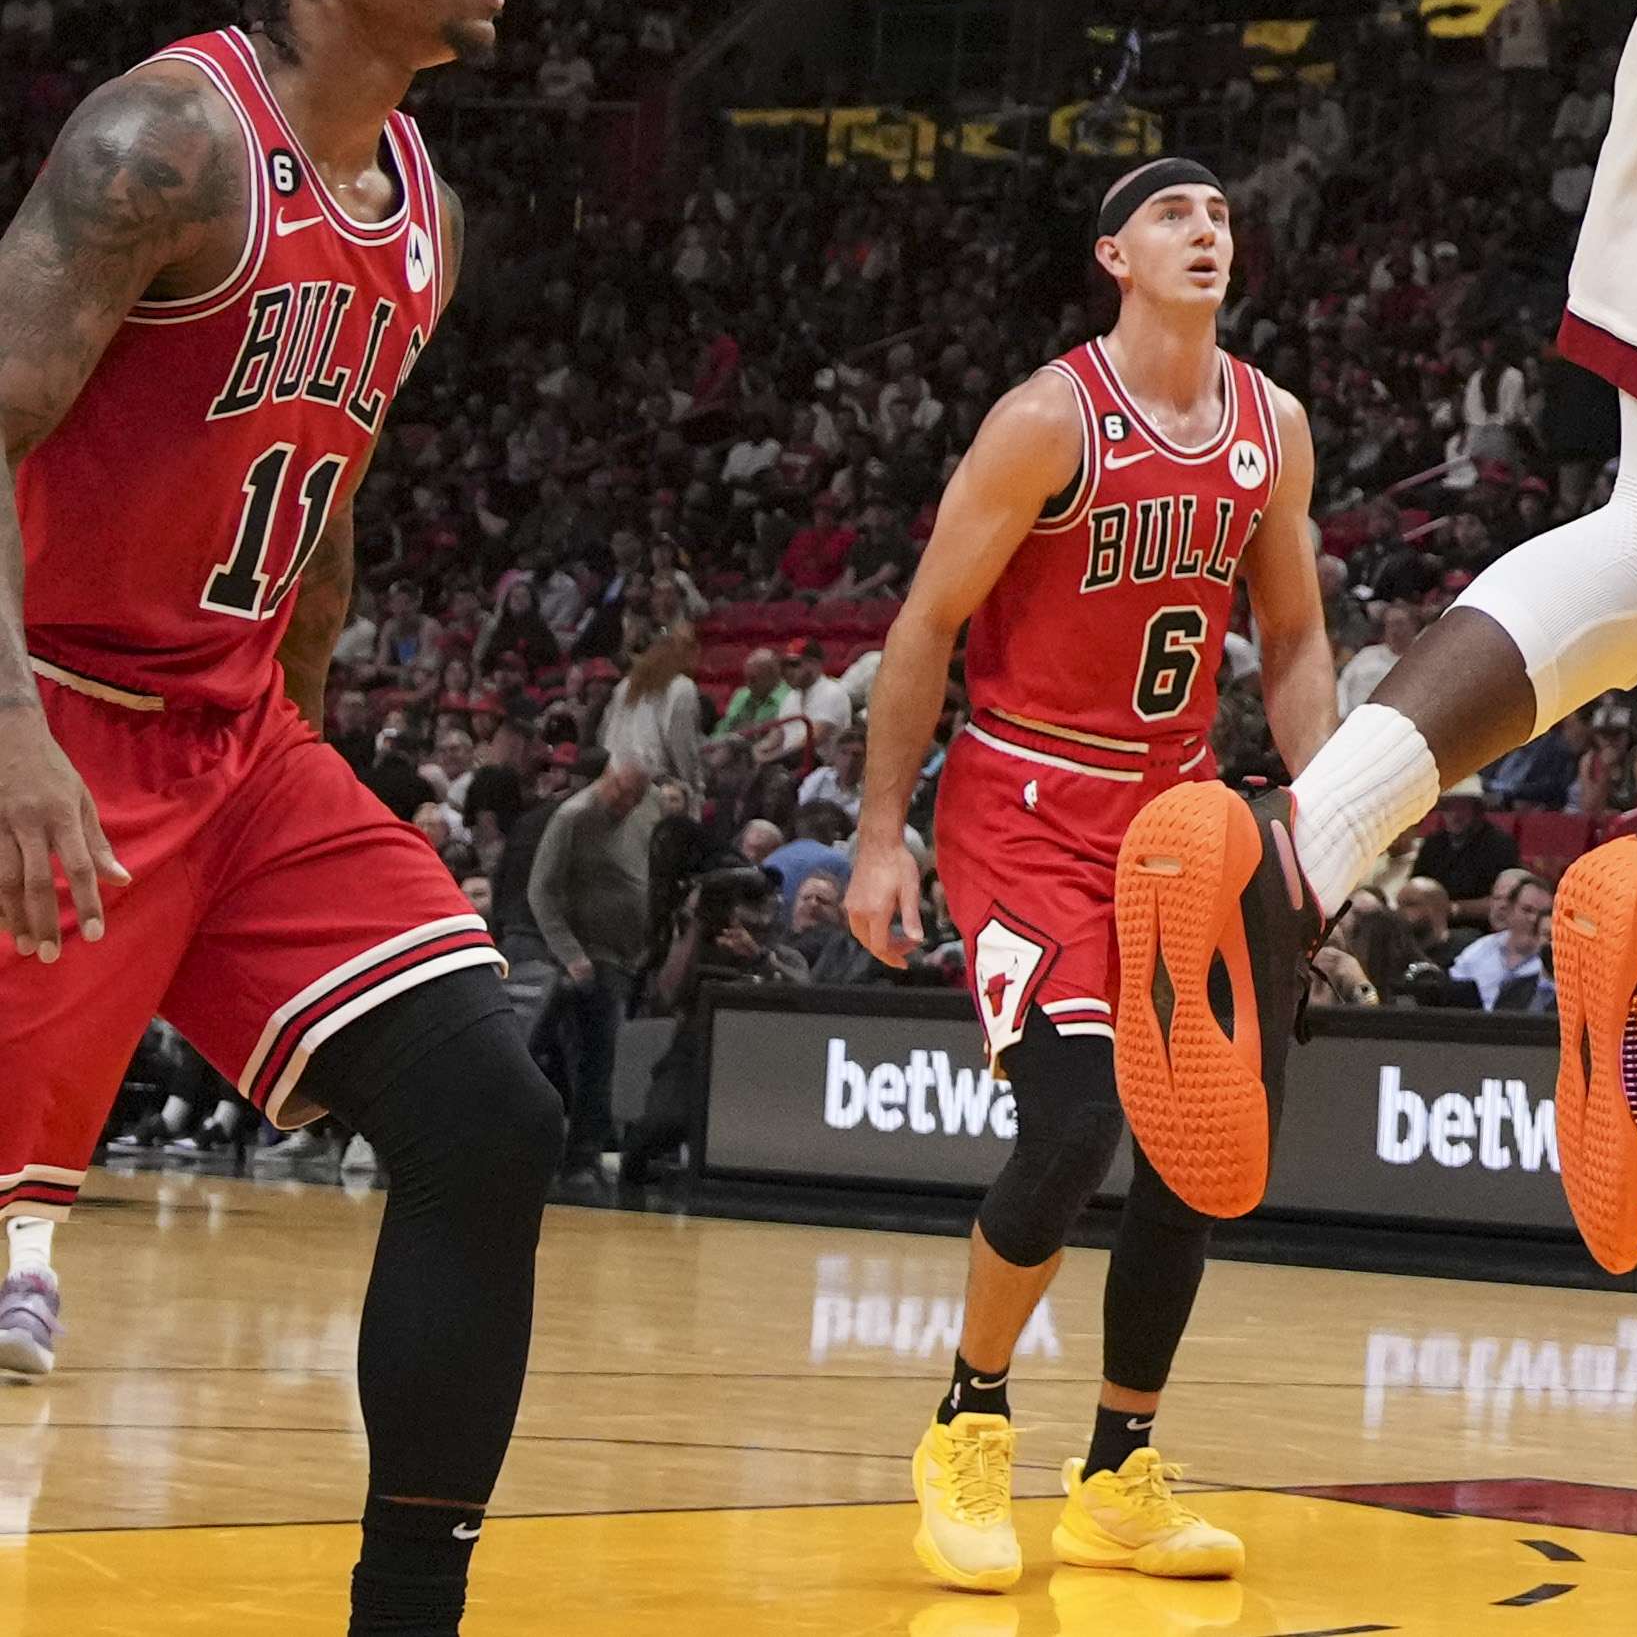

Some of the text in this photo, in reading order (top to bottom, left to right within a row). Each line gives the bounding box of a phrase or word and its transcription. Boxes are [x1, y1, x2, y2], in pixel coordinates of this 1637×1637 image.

[272, 155, 294, 192] 6
[1104, 415, 1125, 440] 6
[199, 441, 349, 621] 11
[1080, 495, 1262, 594] BULL
[1132, 605, 1208, 722] 6
[823, 1037, 1019, 1140] betwa
[1377, 1066, 1561, 1172] betw
